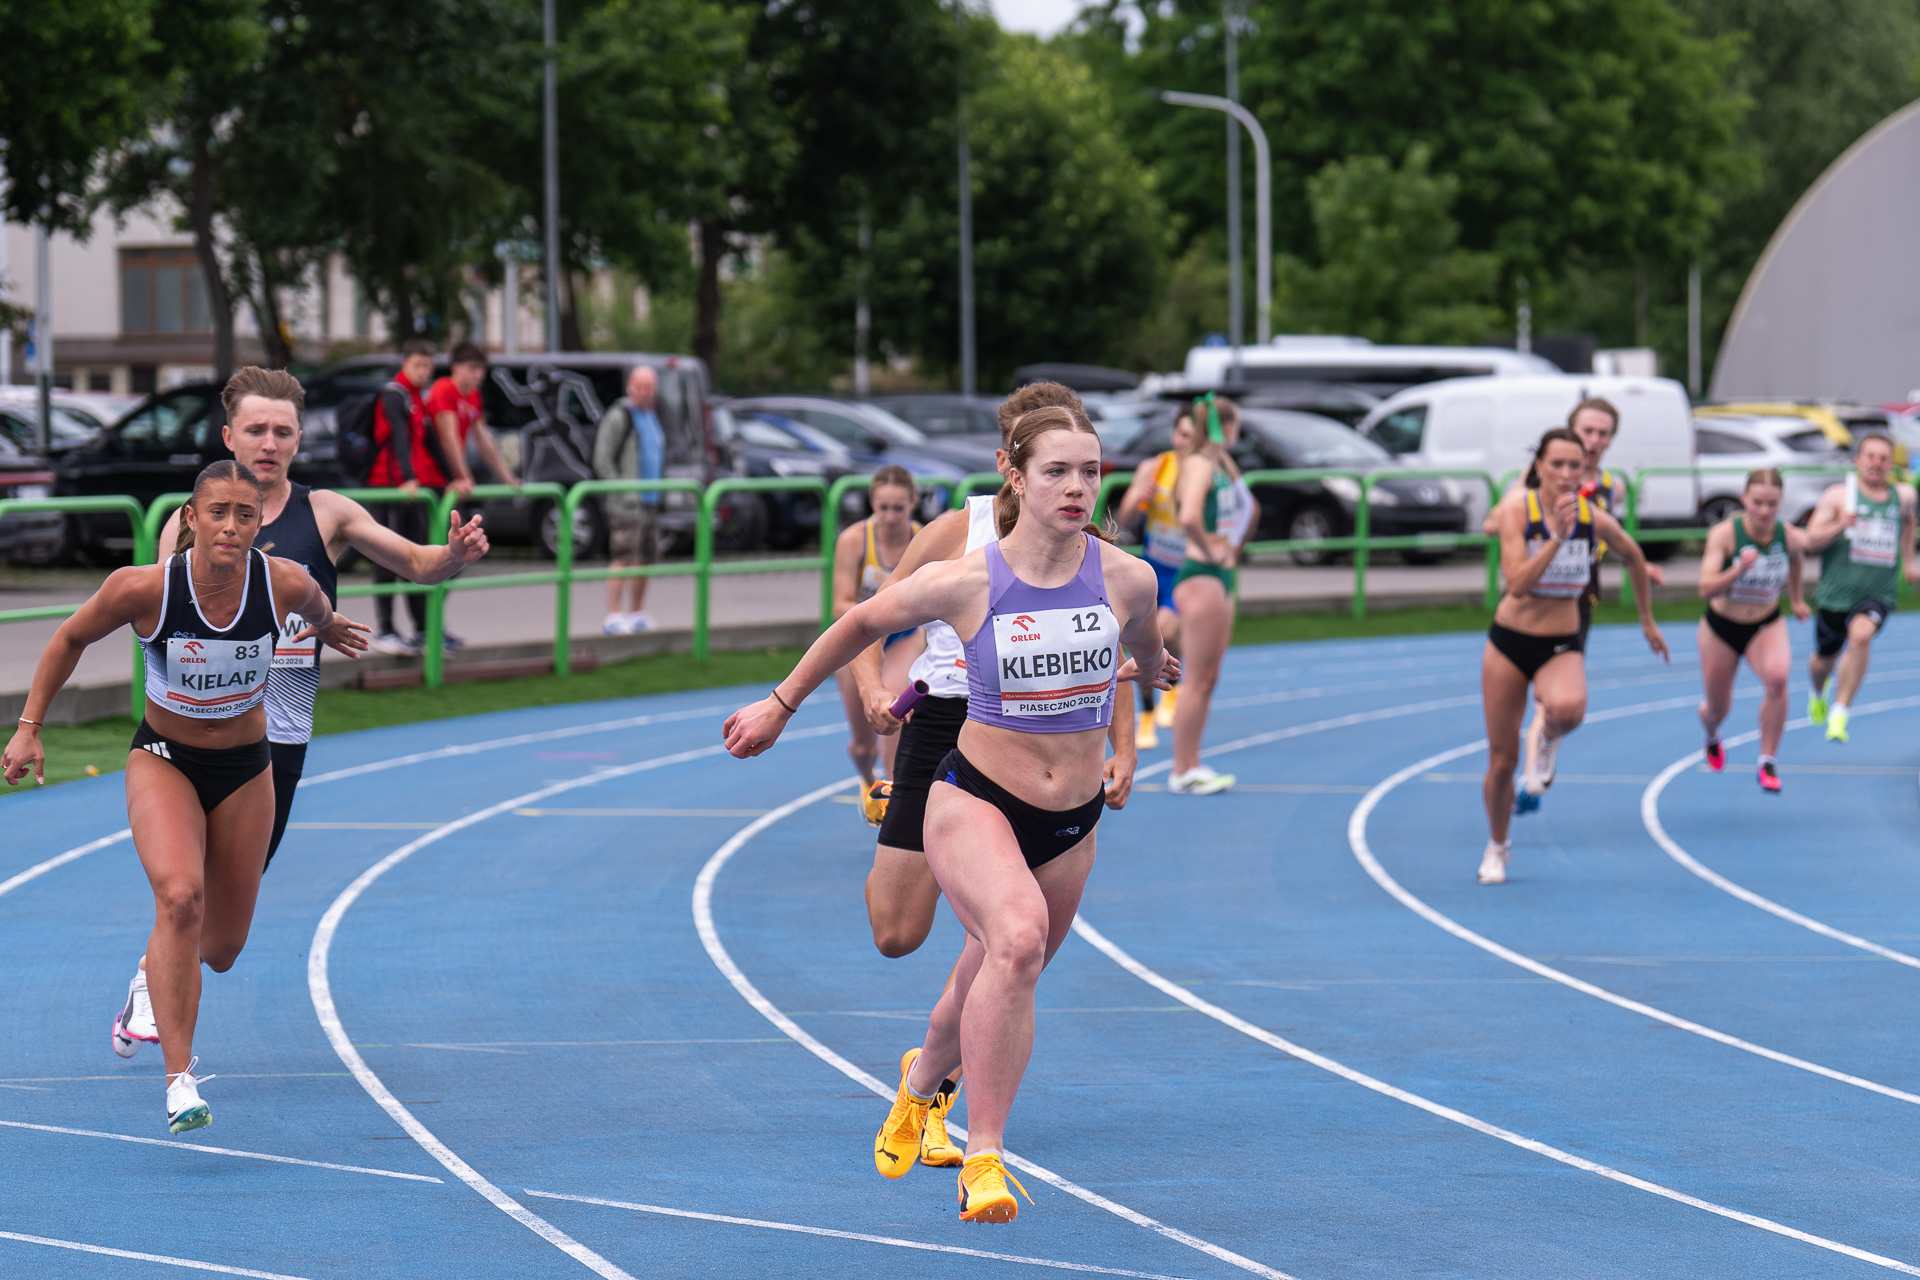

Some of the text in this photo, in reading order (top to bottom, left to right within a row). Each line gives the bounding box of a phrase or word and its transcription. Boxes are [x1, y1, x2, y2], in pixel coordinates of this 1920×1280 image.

[1072, 612, 1101, 633] 12
[1010, 633, 1041, 642] ORLEN
[235, 644, 260, 660] 83
[1002, 647, 1112, 679] KLEBIEKO
[181, 670, 258, 691] KIELAR
[179, 704, 232, 714] PIASECZNO
[1019, 695, 1102, 712] PIASECZNO 2026
